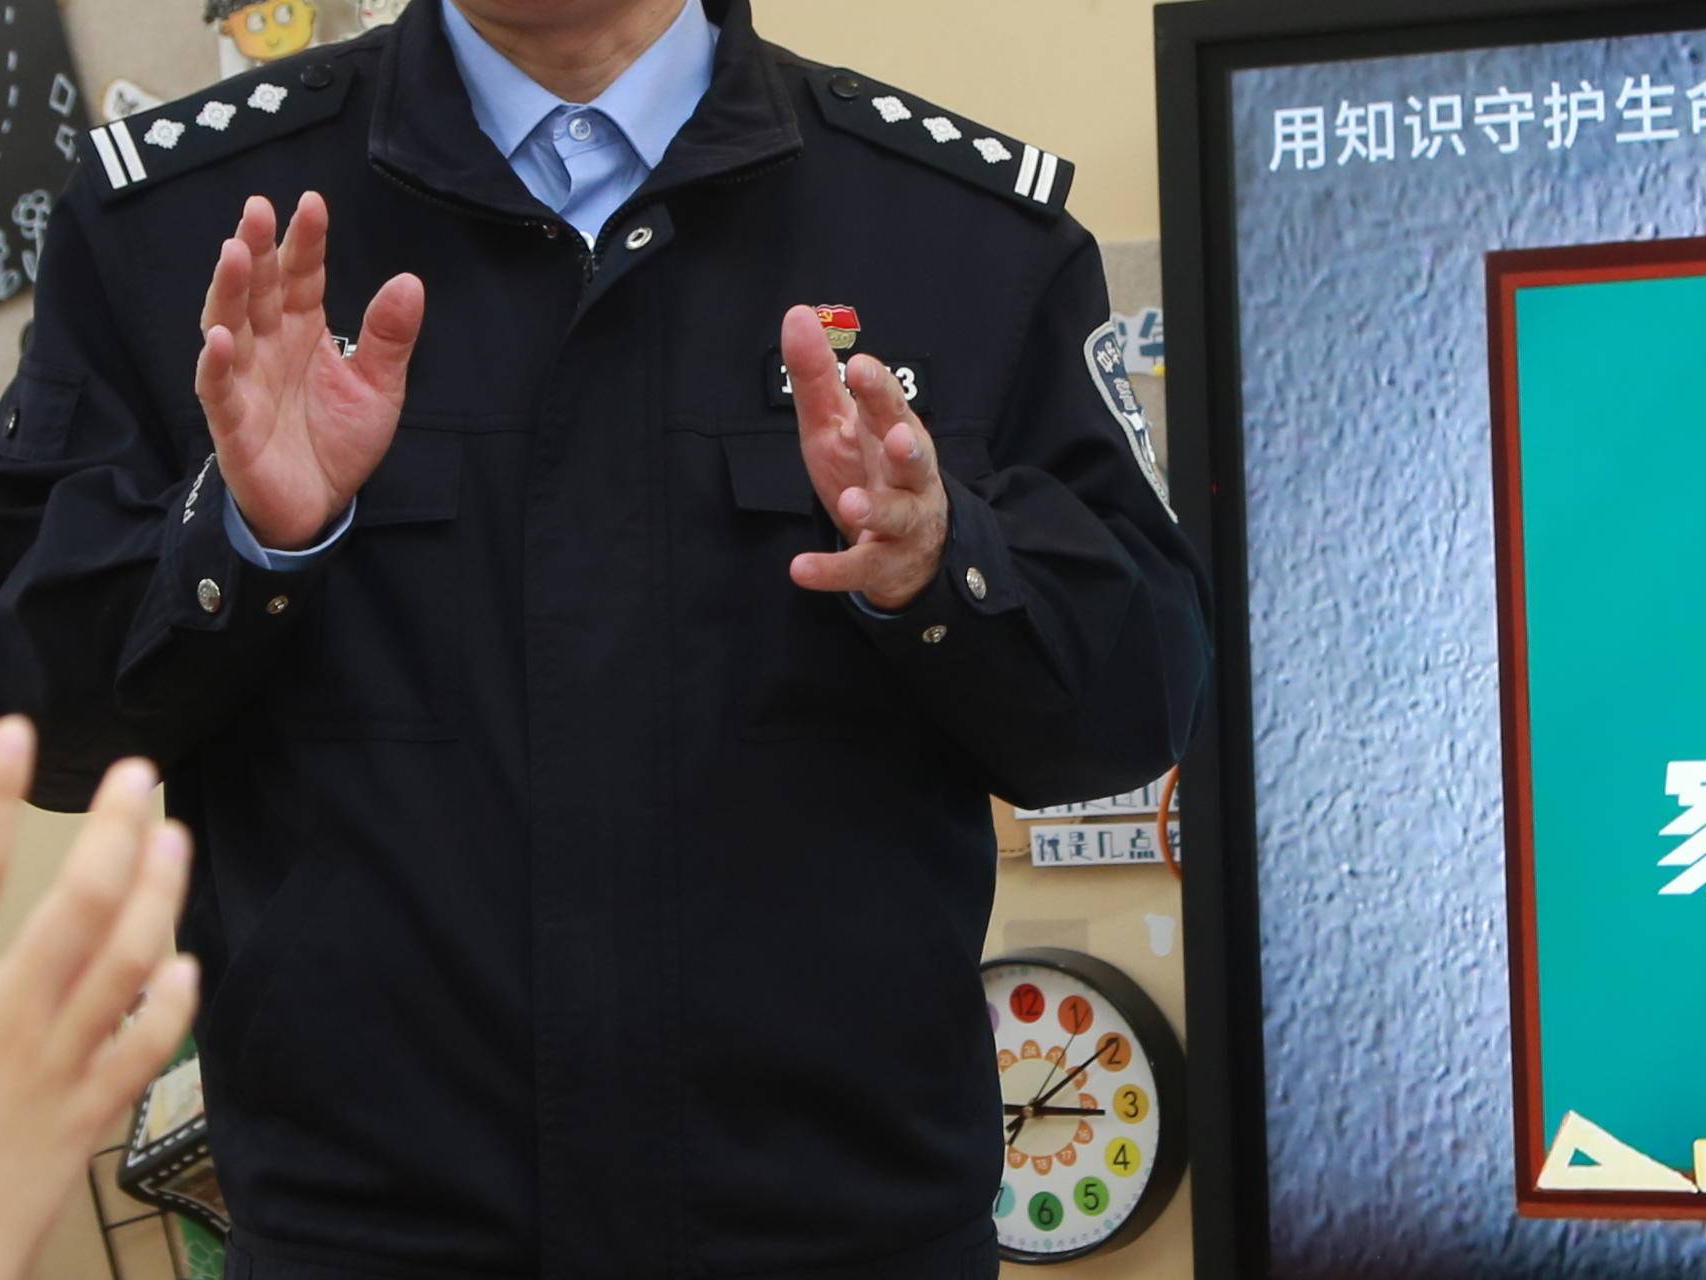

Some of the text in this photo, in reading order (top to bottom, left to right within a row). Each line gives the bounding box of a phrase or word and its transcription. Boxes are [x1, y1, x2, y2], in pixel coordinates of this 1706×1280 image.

[1016, 989, 1038, 1017] 12
[1106, 1037, 1122, 1065] 2
[1122, 1090, 1140, 1119] 3
[1112, 1144, 1131, 1172] 4
[1083, 1183, 1100, 1211] 5
[1037, 1197, 1054, 1226] 6
